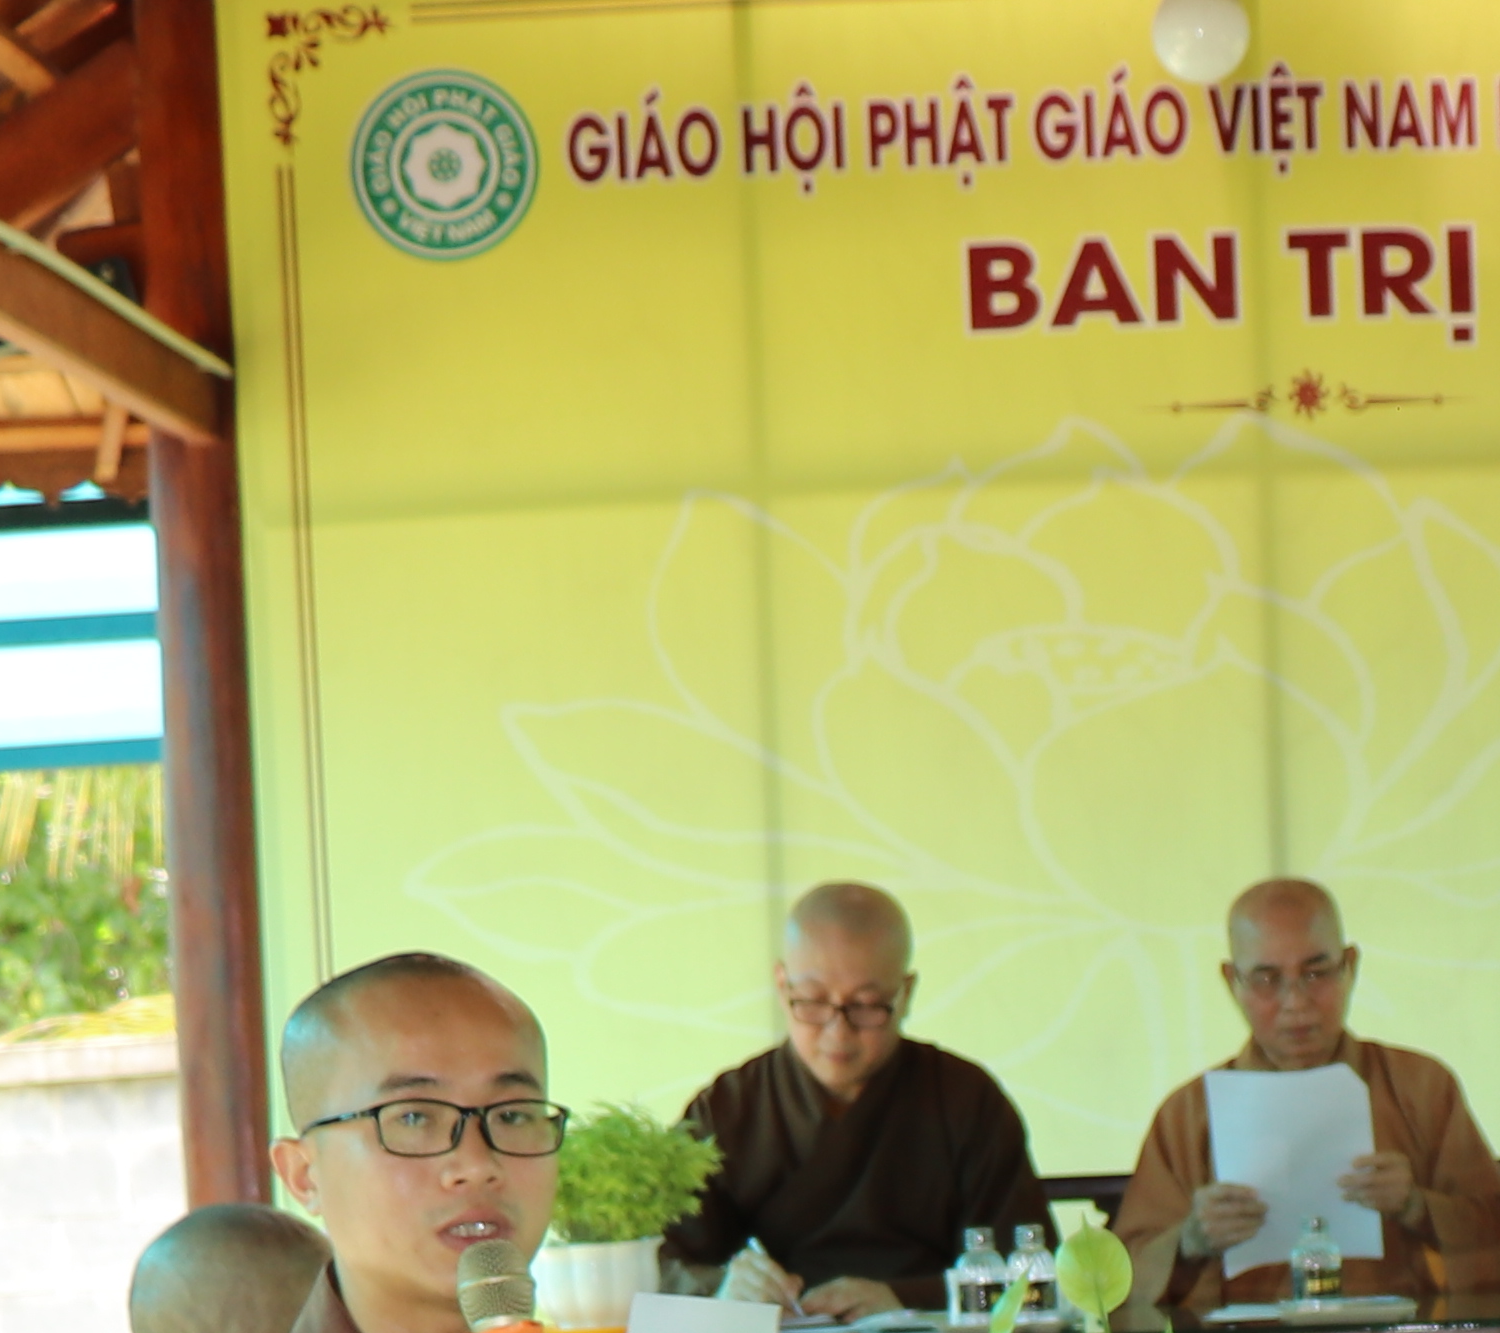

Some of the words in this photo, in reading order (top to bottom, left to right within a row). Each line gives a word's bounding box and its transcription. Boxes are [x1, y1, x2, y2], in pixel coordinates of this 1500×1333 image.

[568, 90, 721, 184] GIÁO
[742, 82, 845, 194] HỘI
[869, 77, 1015, 188] PHẬT
[1033, 68, 1189, 160] GIÁO
[1210, 64, 1322, 174] VIỆT
[1345, 78, 1477, 151] NAM
[967, 232, 1238, 331] BAN
[1288, 224, 1473, 342] TRỊ
